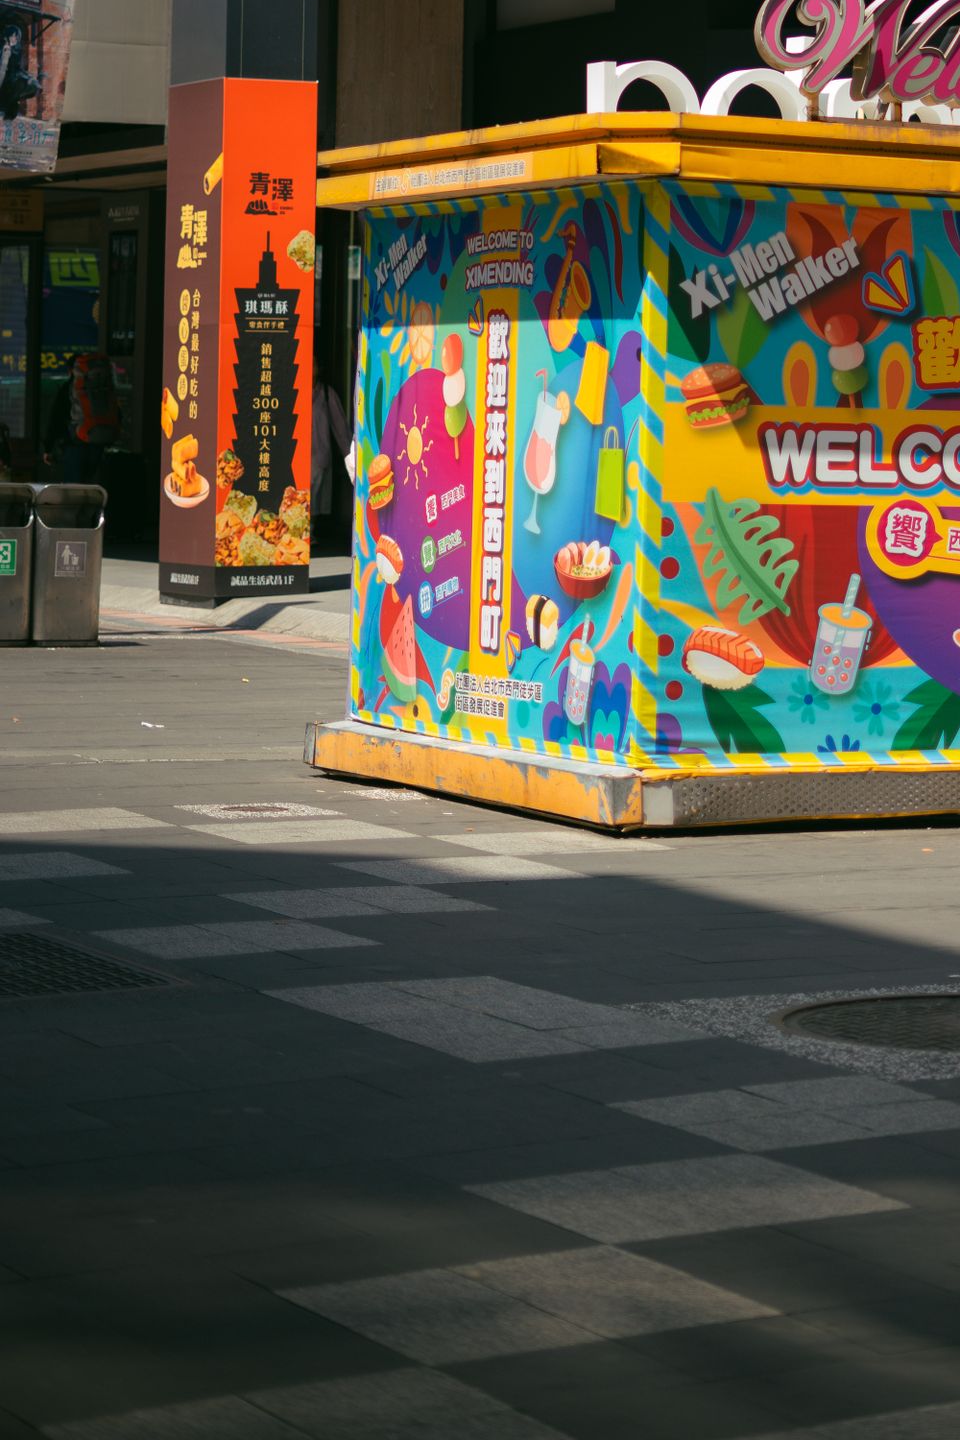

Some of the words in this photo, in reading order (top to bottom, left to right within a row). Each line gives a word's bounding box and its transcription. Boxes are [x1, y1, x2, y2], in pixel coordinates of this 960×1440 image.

[249, 171, 294, 202] 青澤
[374, 232, 408, 291] Xi-Men
[393, 232, 428, 291] Walker
[467, 231, 519, 255] WELCOME
[519, 231, 534, 250] TO
[465, 261, 535, 292] XIMENDING
[679, 231, 796, 320] Xi-Men
[747, 236, 861, 322] Walker
[244, 299, 289, 315] 琪瑪酥
[188, 288, 202, 420] 台灣最好吃的
[480, 314, 509, 651] 歡迎來到西門町
[455, 673, 543, 702] 社團法人台北市西門徒步區
[455, 695, 505, 719] 街區發展促進會
